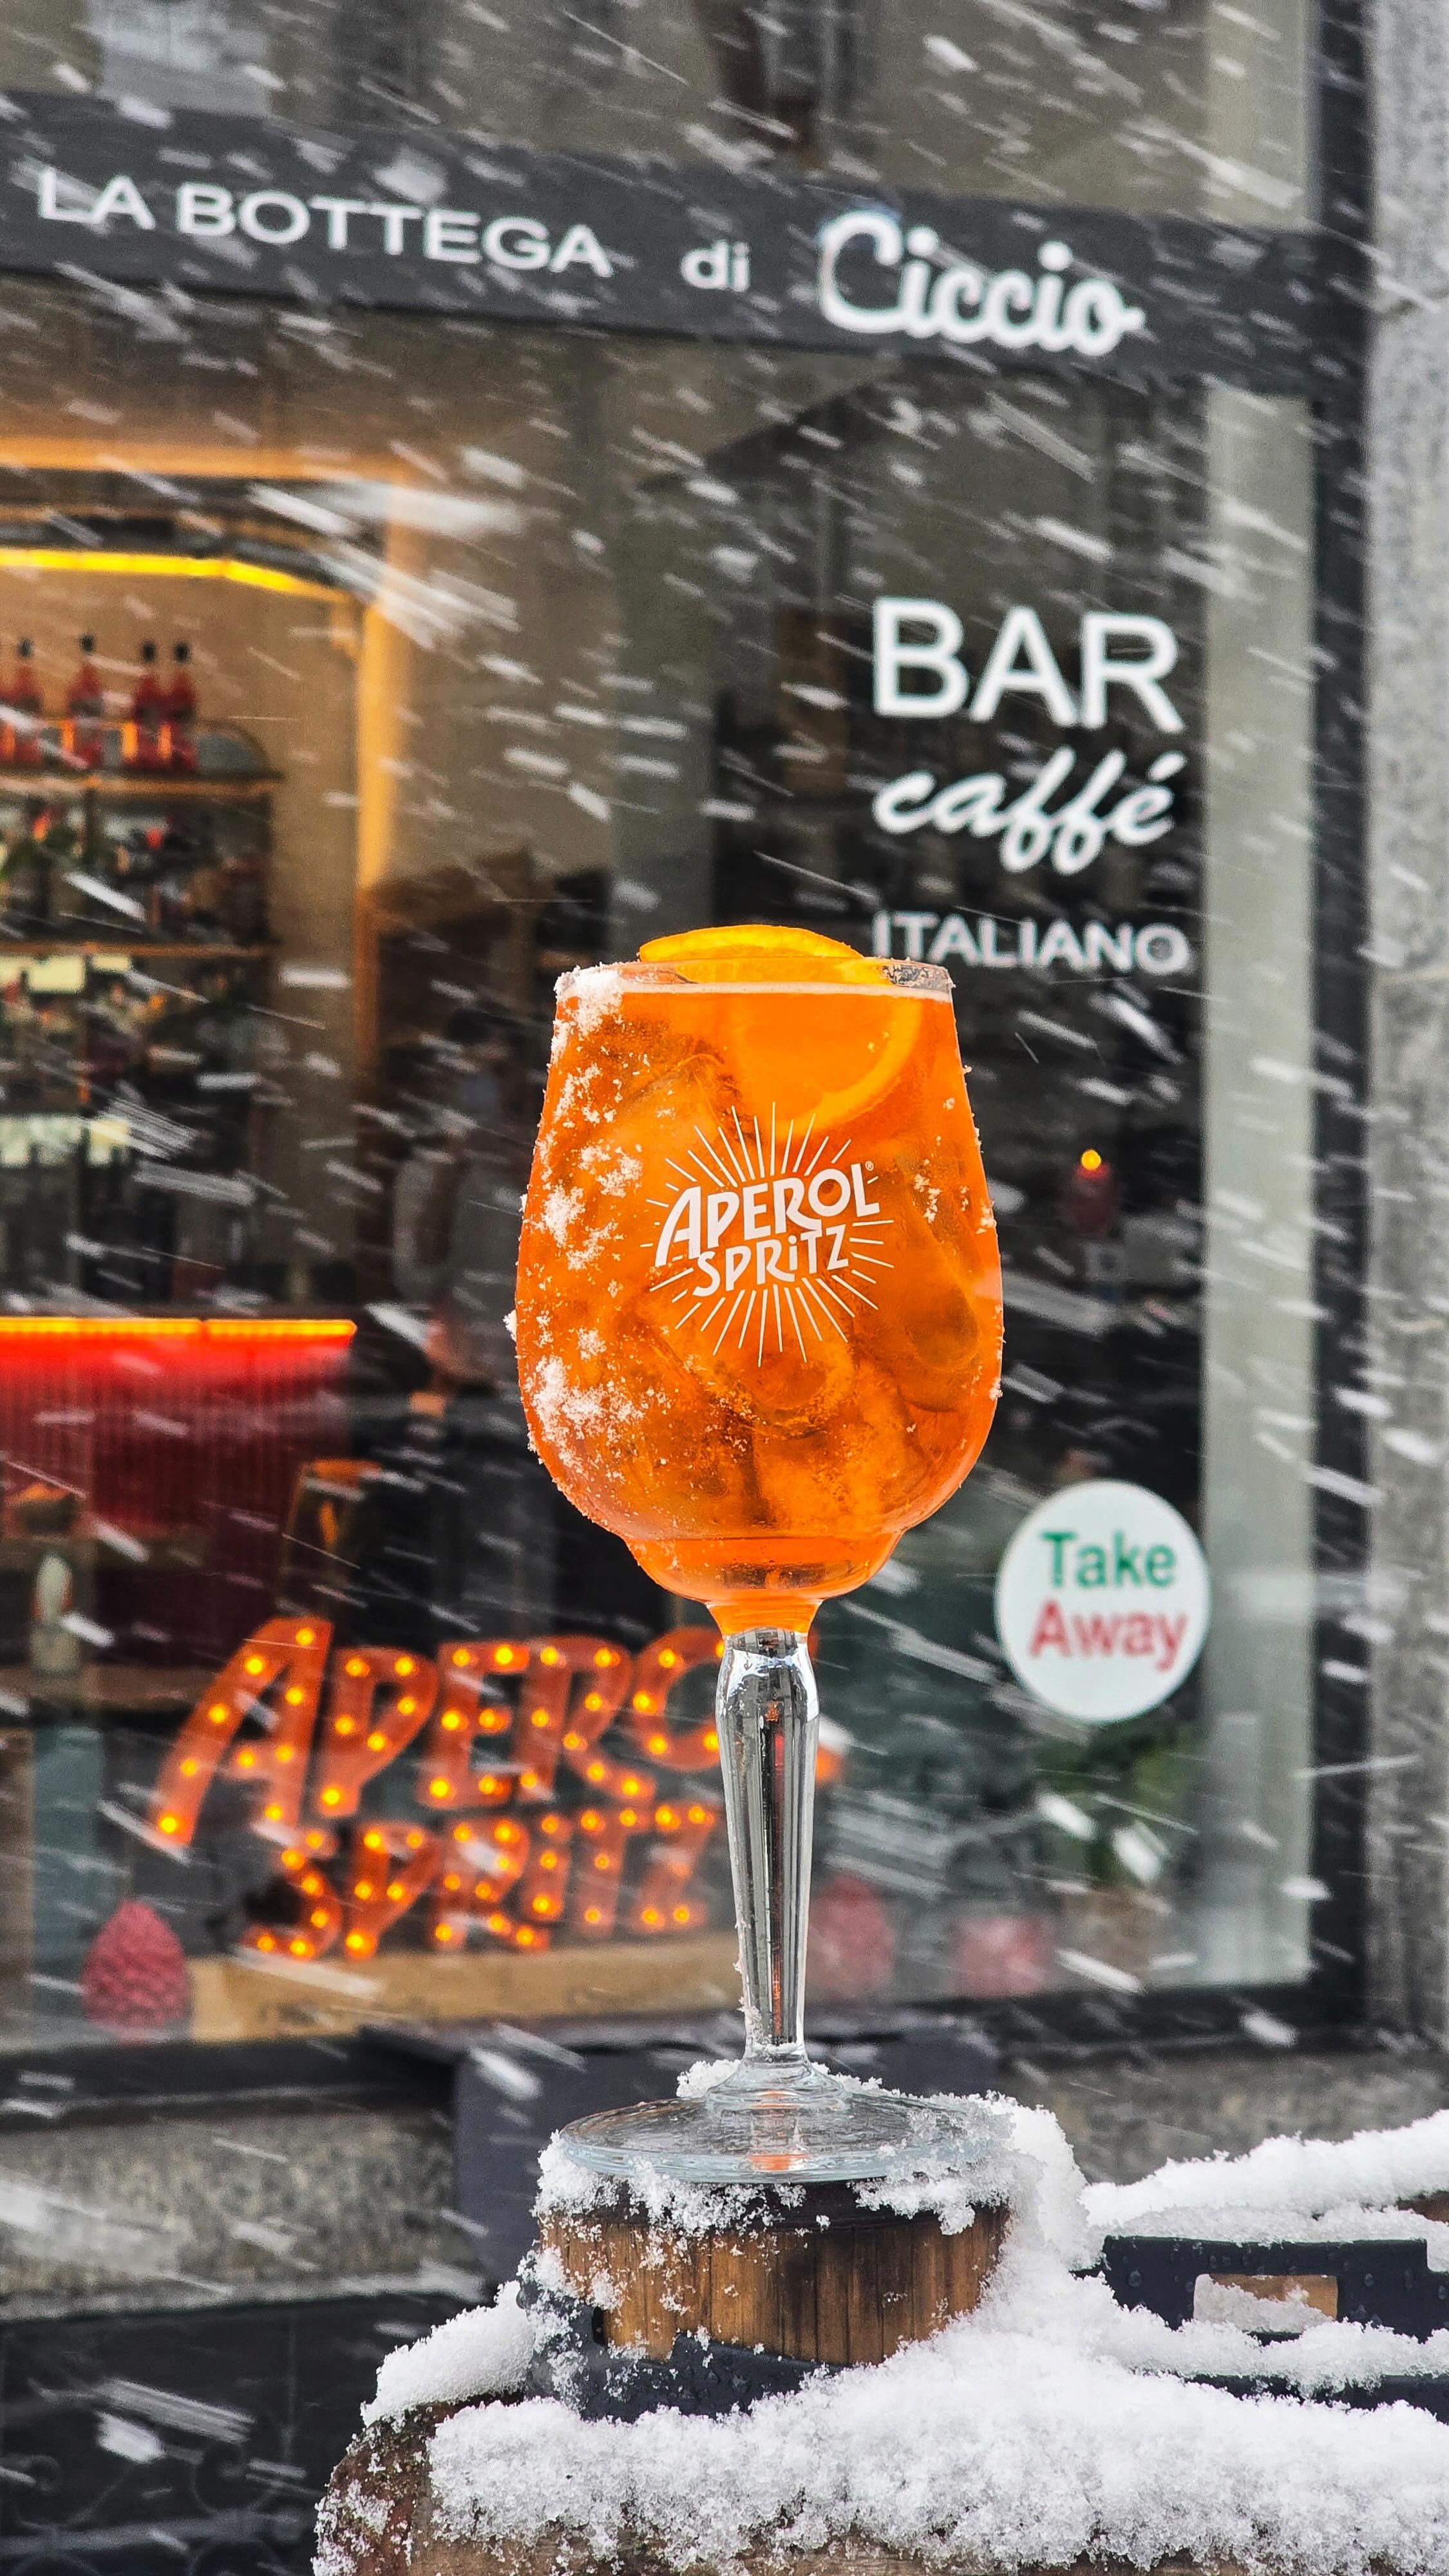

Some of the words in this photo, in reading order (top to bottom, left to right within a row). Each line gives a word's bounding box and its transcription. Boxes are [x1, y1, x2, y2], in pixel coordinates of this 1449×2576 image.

[39, 169, 155, 229] LA
[176, 182, 614, 278] BOTTEGA
[680, 240, 750, 292] di
[818, 209, 1146, 355] Ciccio
[873, 598, 1184, 733] BAR
[873, 746, 1187, 875] caffé
[873, 911, 1193, 976] ITALIANO
[1040, 1529, 1177, 1589] Take
[1028, 1598, 1190, 1673] Away
[155, 1615, 845, 1847] APERO
